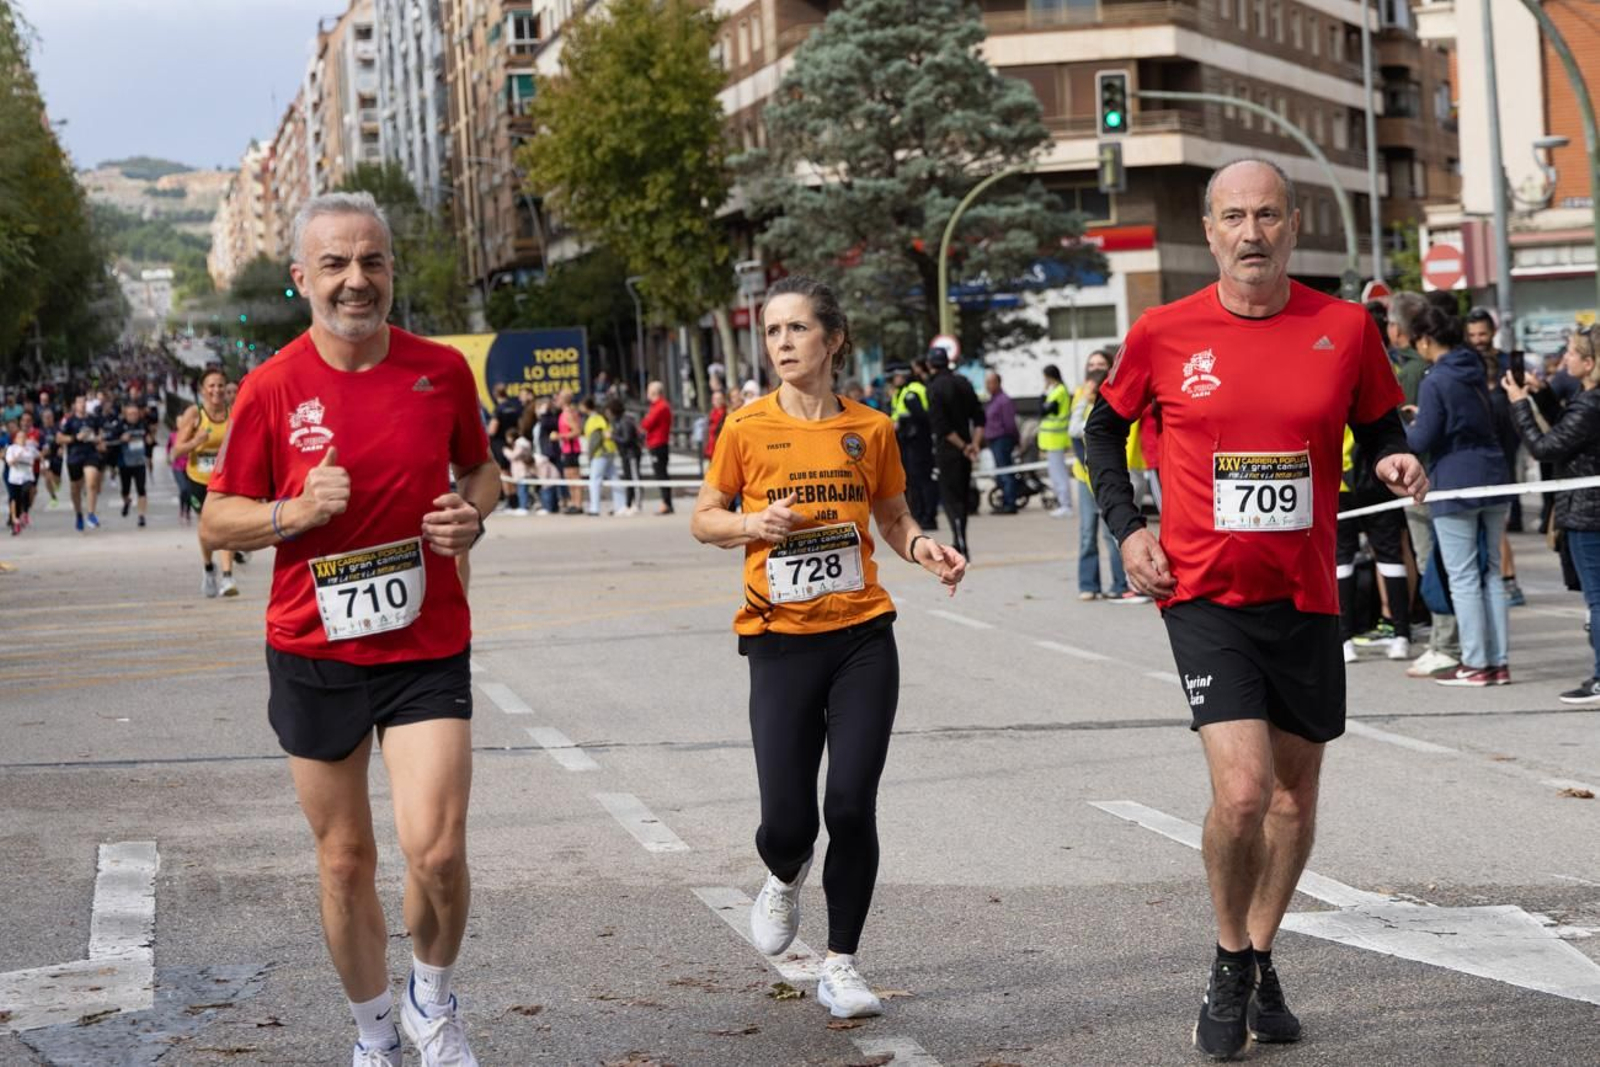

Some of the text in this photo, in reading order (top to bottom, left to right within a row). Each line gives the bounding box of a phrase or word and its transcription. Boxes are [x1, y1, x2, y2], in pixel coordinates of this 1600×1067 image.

[533, 348, 578, 363] TODO
[524, 363, 579, 381] LO QUE
[1218, 457, 1240, 471] XXV
[1241, 457, 1278, 465] CARRERA
[1251, 464, 1273, 472] gran
[789, 472, 807, 481] CLUB
[808, 471, 818, 479] DE
[1235, 485, 1297, 513] 709
[821, 531, 855, 542] caminata
[316, 559, 337, 578] XXV
[337, 552, 376, 566] CARRERA
[349, 561, 373, 573] gran
[376, 551, 417, 565] caminata
[786, 554, 842, 585] 728
[338, 578, 408, 618] 710
[1185, 674, 1213, 690] Sprint
